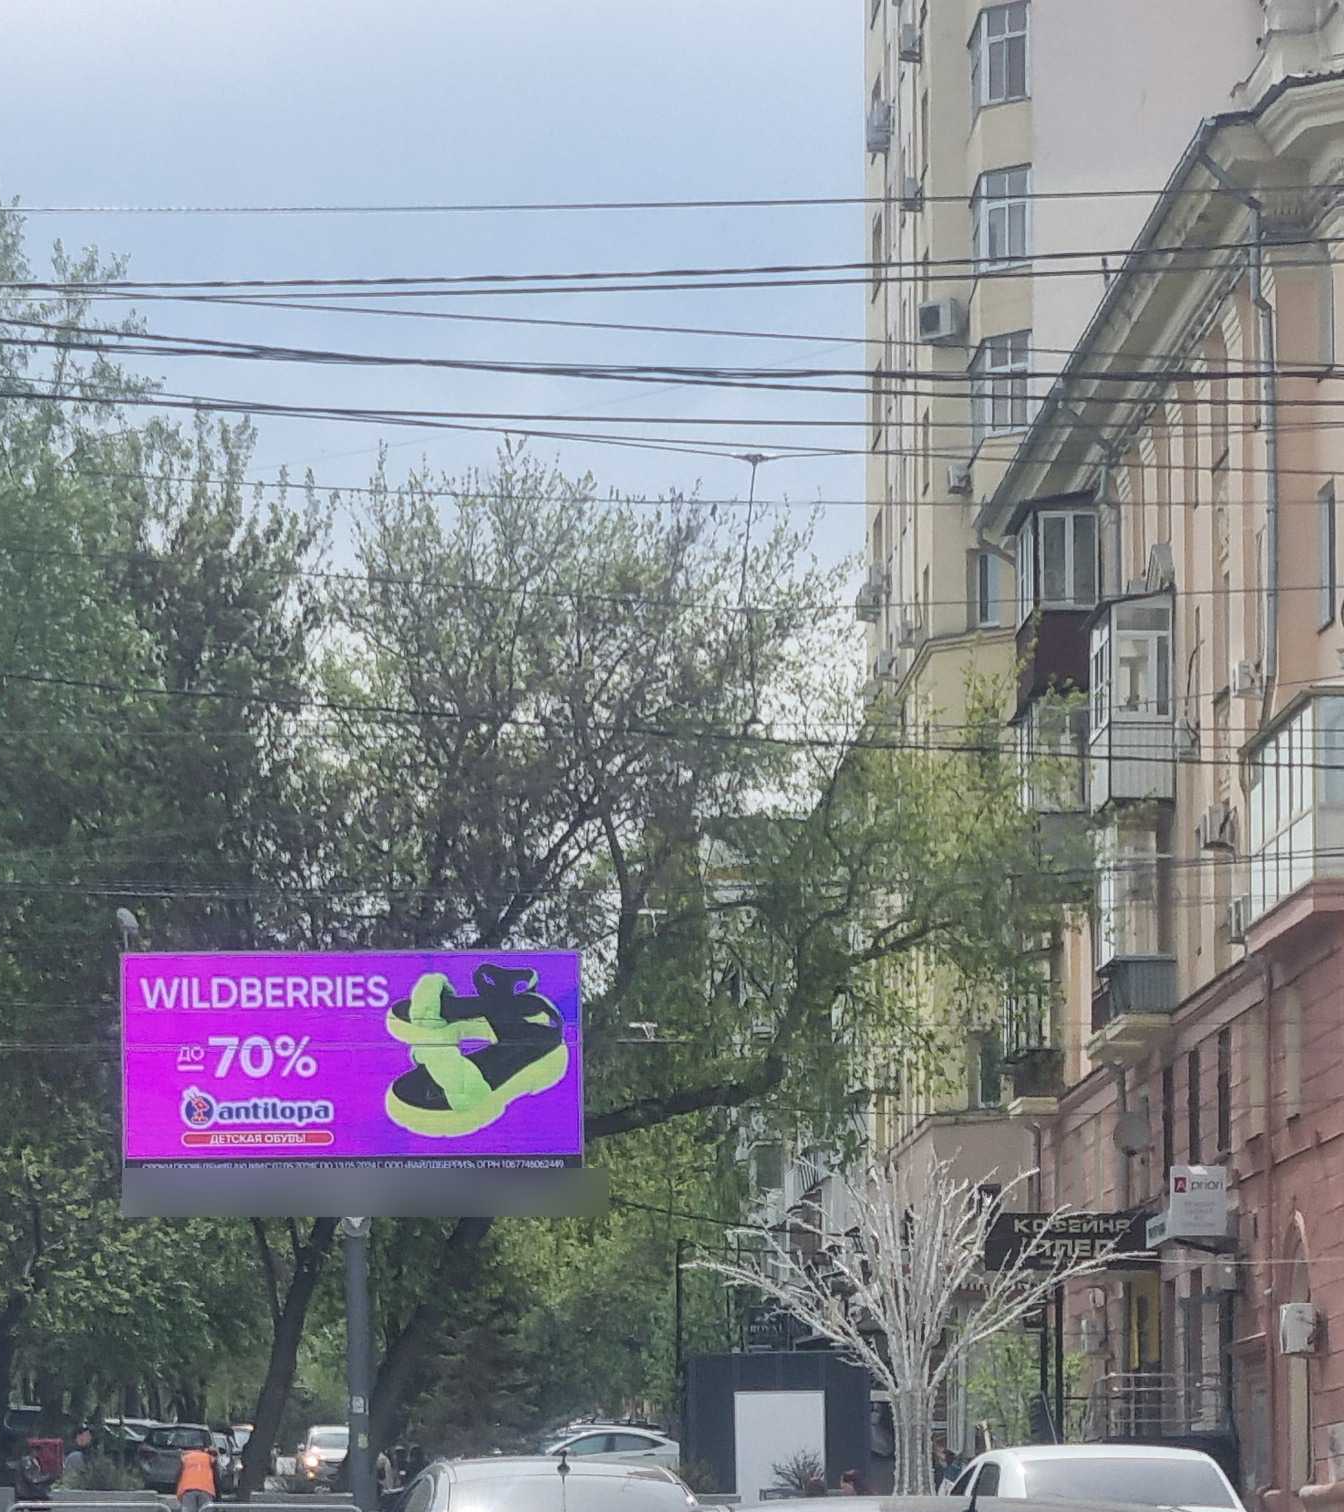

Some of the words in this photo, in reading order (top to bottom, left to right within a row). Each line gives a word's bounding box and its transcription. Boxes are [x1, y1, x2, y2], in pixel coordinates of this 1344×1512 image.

[140, 975, 390, 1009] WILDBERRIES
[208, 1035, 318, 1078] 70%
[218, 1101, 330, 1122] antilopa
[210, 1134, 262, 1145] ДЕТСКАЯ
